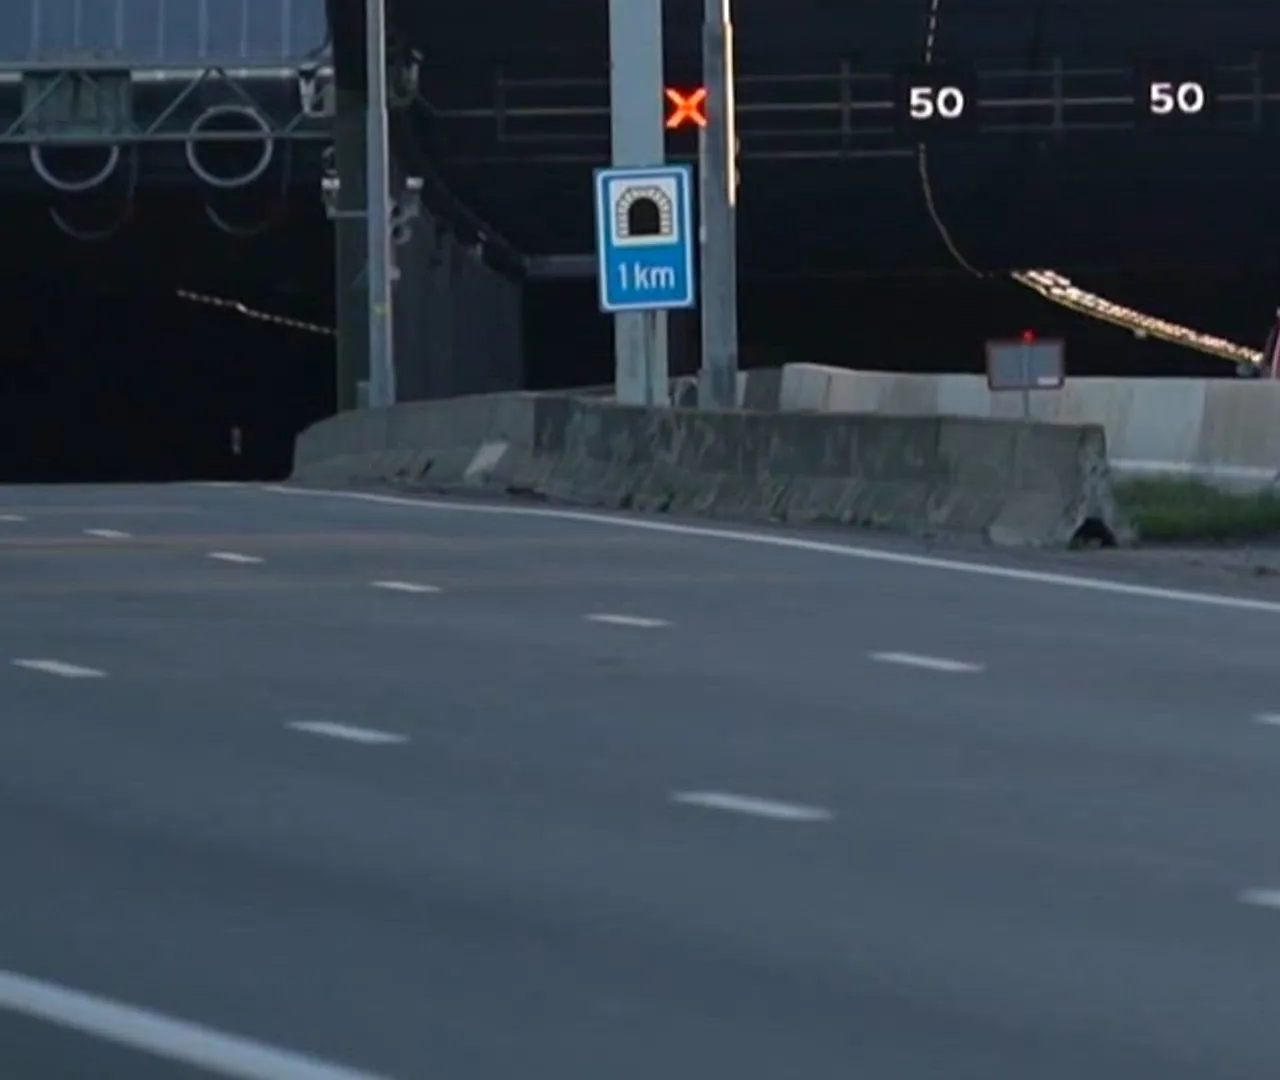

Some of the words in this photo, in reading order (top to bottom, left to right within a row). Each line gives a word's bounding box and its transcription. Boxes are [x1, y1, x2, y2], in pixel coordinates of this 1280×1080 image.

[909, 86, 965, 120] 50
[1149, 81, 1205, 114] 50
[618, 261, 628, 291] 1
[634, 261, 676, 291] km
